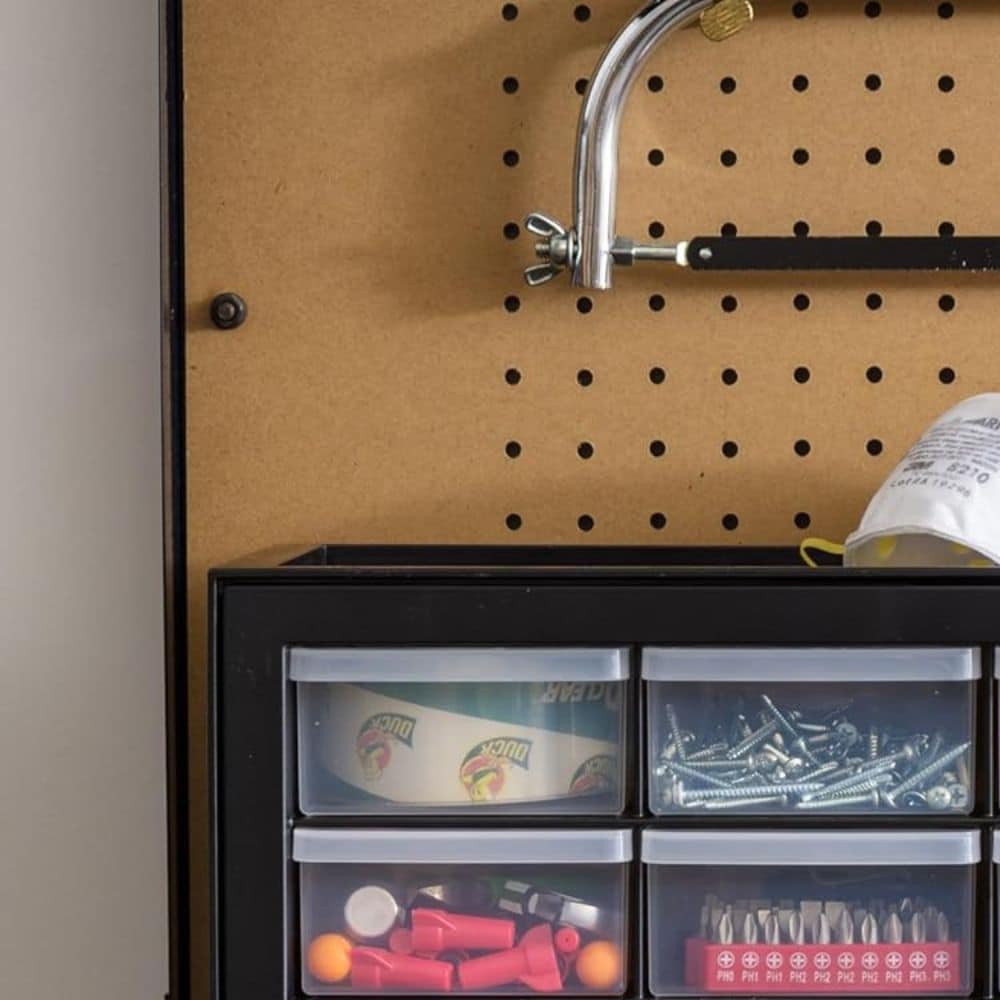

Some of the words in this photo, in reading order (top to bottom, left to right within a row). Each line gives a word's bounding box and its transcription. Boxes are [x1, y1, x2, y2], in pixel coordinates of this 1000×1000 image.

[373, 715, 414, 738] DUCK
[480, 738, 530, 759] DUCK
[814, 970, 831, 983] PH2
[838, 970, 855, 983] PH2
